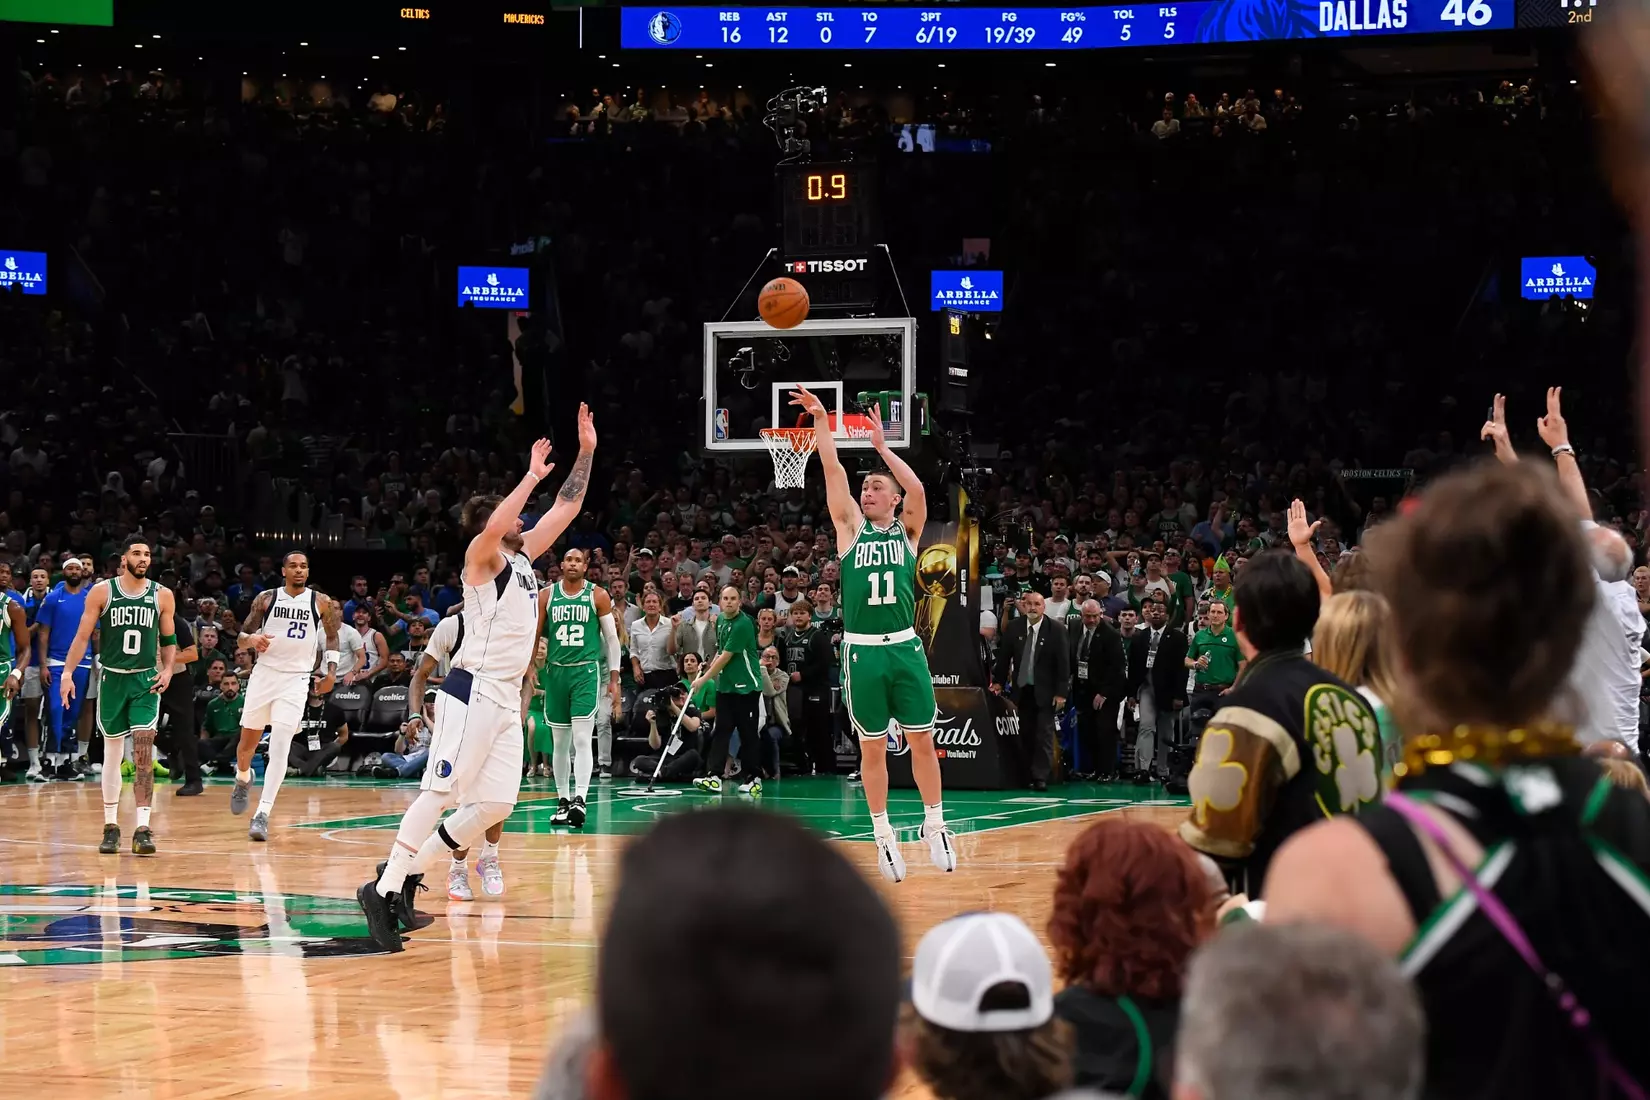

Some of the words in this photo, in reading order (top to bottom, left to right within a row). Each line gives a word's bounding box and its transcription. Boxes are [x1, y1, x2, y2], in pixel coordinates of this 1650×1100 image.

[400, 8, 430, 19] CELTICS
[503, 13, 545, 24] MAVERICKS
[719, 12, 741, 22] REB
[766, 12, 788, 22] AST
[816, 12, 835, 22] STL
[861, 12, 878, 22] TO
[920, 12, 942, 22] 3PT
[1002, 12, 1018, 22] FG
[1060, 12, 1086, 22] FG%
[1113, 10, 1135, 20] TOL
[1159, 8, 1178, 18] FLS
[1320, 0, 1407, 31] DALLAS
[1440, 0, 1492, 26] 46
[1568, 8, 1592, 24] 2nd
[721, 26, 742, 43] 16
[768, 26, 788, 43] 12
[820, 26, 832, 44] 0
[864, 26, 877, 43] 7
[915, 26, 958, 44] 6/19
[985, 26, 1036, 44] 19/39
[1061, 26, 1083, 43] 49
[1120, 24, 1131, 41] 5
[1163, 22, 1175, 39] 5
[807, 174, 846, 201] 0.9
[807, 258, 868, 272] TISSOT
[0, 271, 42, 281] BELLA
[1525, 276, 1591, 287] ARBELLA
[462, 286, 524, 296] ARBELLA
[935, 290, 998, 299] ARBELLA
[854, 539, 905, 569] BOSTON
[867, 570, 897, 606] 11
[110, 605, 155, 629] BOSTON
[273, 606, 310, 621] DALLAS
[552, 604, 590, 623] BOSTON
[286, 621, 308, 640] 25
[555, 624, 584, 647] 42
[122, 629, 142, 655] 0
[932, 674, 960, 684] uTubeTV
[932, 716, 982, 746] nals
